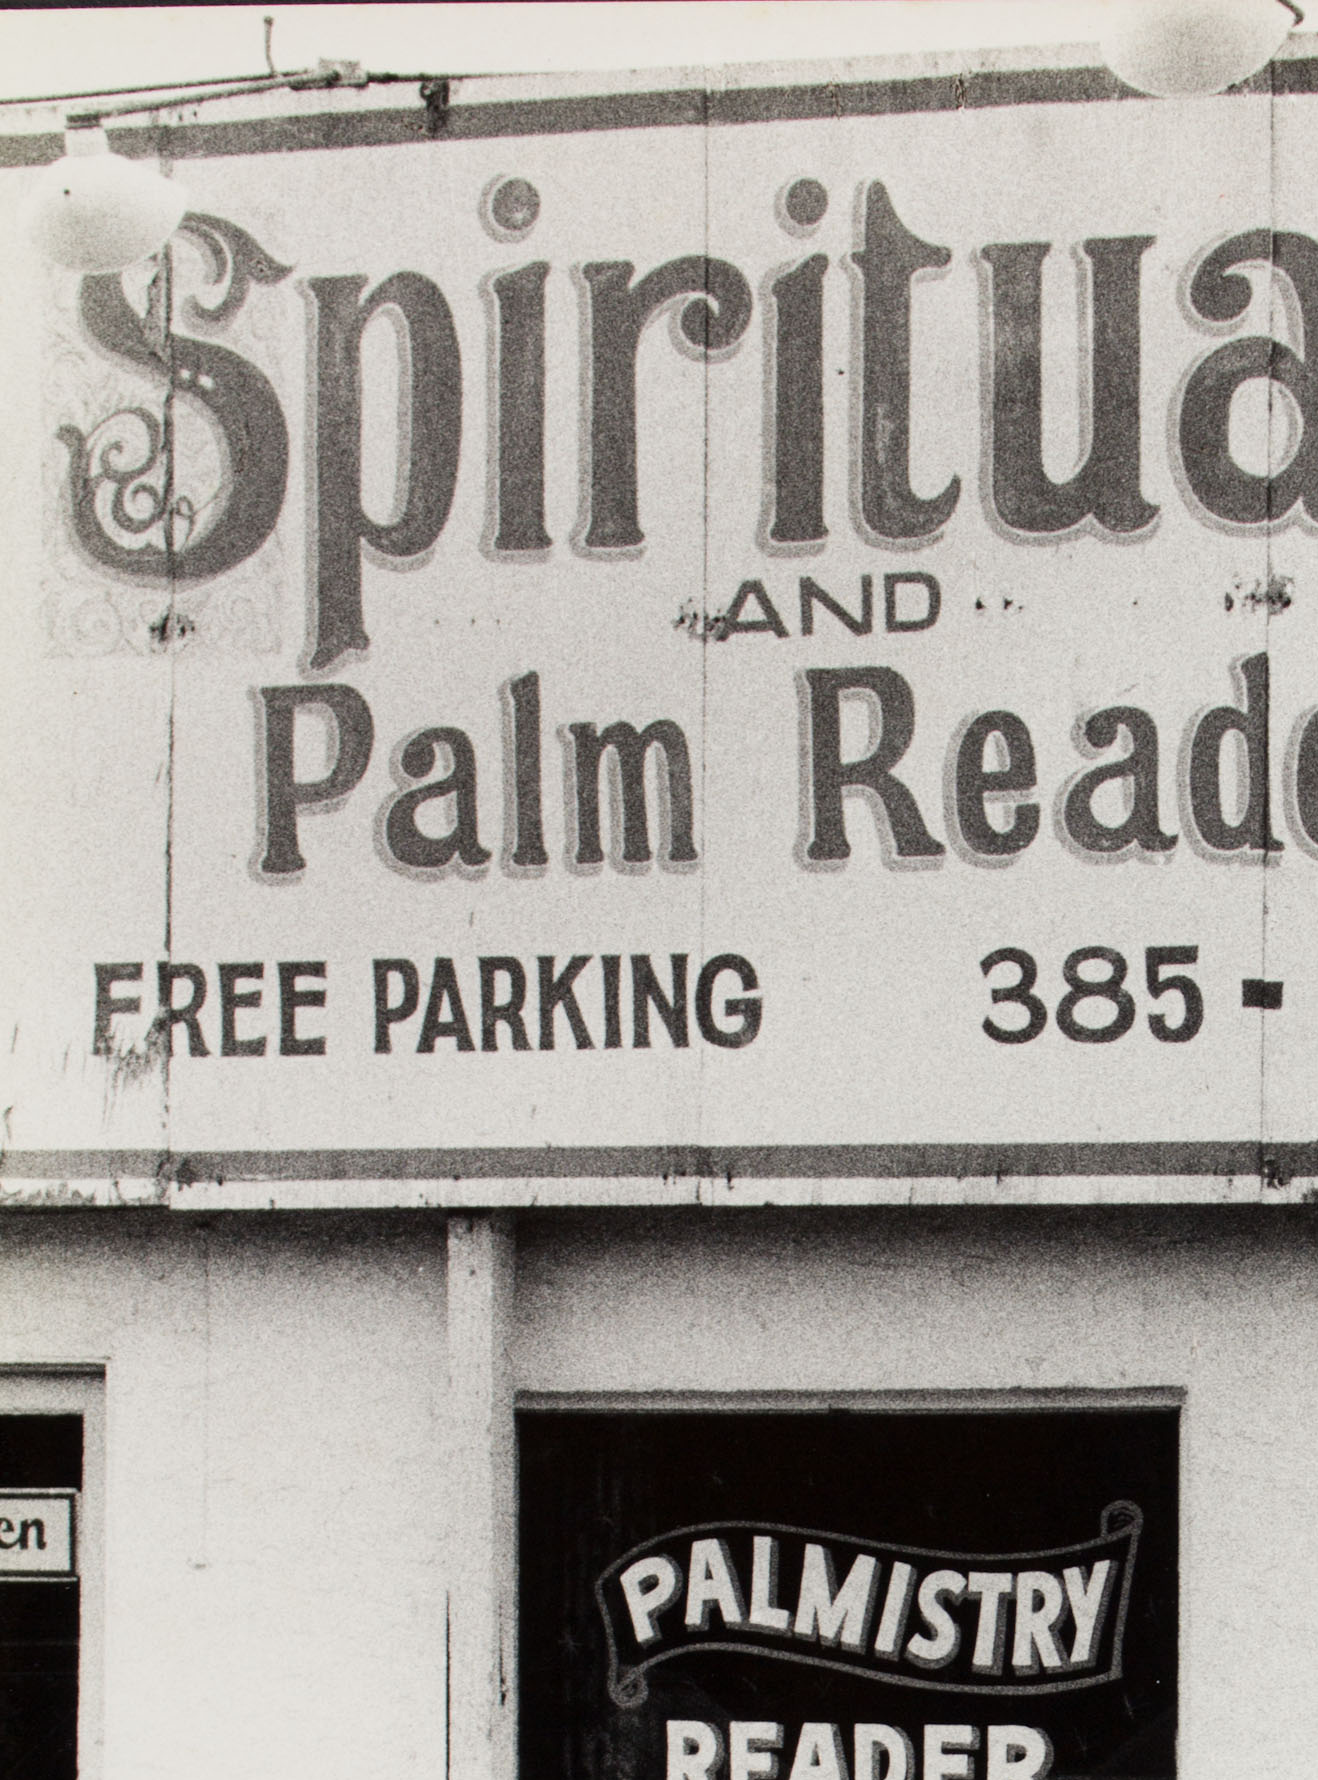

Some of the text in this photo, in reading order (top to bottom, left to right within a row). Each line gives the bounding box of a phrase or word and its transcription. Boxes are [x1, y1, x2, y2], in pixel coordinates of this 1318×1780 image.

[722, 571, 942, 641] AND
[247, 670, 703, 885] Palm
[93, 960, 329, 1058] FREE
[371, 953, 764, 1055] PARKING
[619, 1535, 1119, 1678] PALMISTRY
